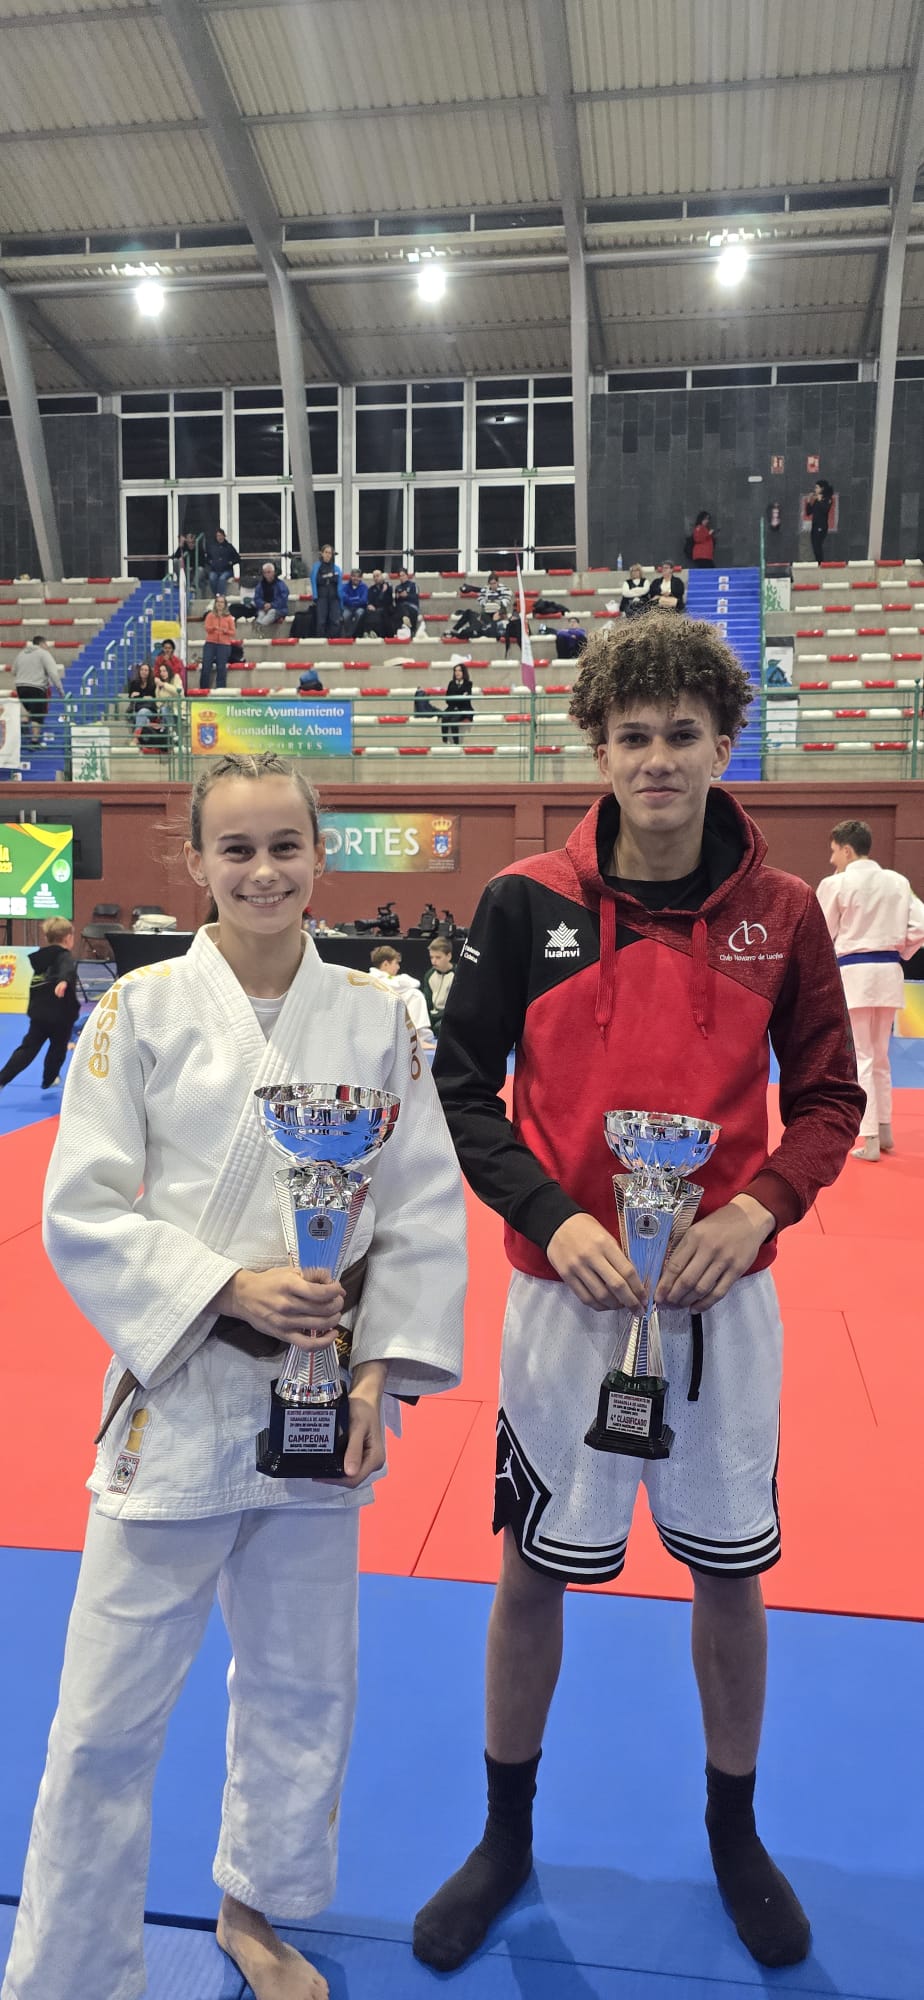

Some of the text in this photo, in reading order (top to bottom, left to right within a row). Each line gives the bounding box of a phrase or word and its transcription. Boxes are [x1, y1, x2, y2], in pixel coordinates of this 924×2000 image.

[226, 705, 345, 720] Ilustre Ayuntamiento
[226, 724, 343, 737] Granadilla de Abona
[758, 952, 766, 960] de
[616, 1415, 648, 1427] CLASIFICADO
[288, 1434, 329, 1443] CAMPEONA
